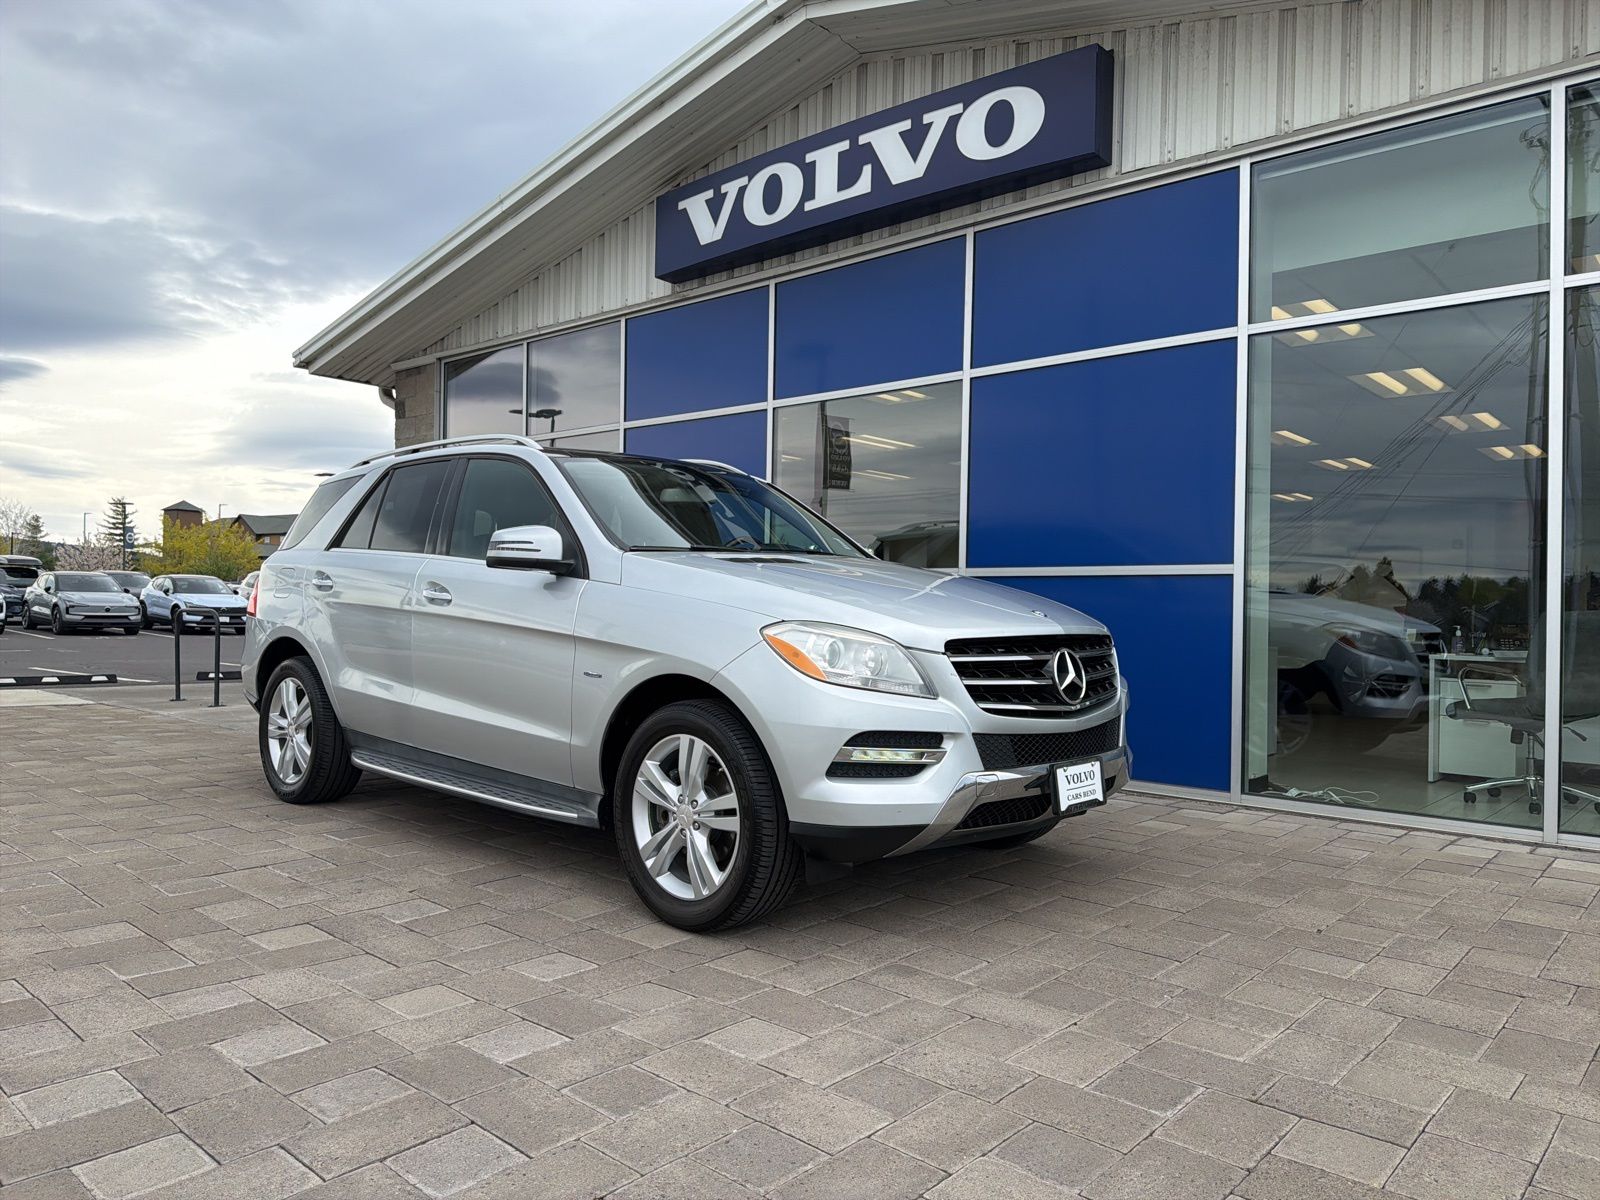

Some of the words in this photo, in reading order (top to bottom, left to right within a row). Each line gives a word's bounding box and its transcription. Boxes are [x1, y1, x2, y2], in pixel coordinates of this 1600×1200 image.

[678, 86, 1045, 246] VOLVO
[1065, 770, 1095, 785] VOLVO
[1067, 791, 1082, 801] CARS
[1083, 789, 1096, 798] BEND
